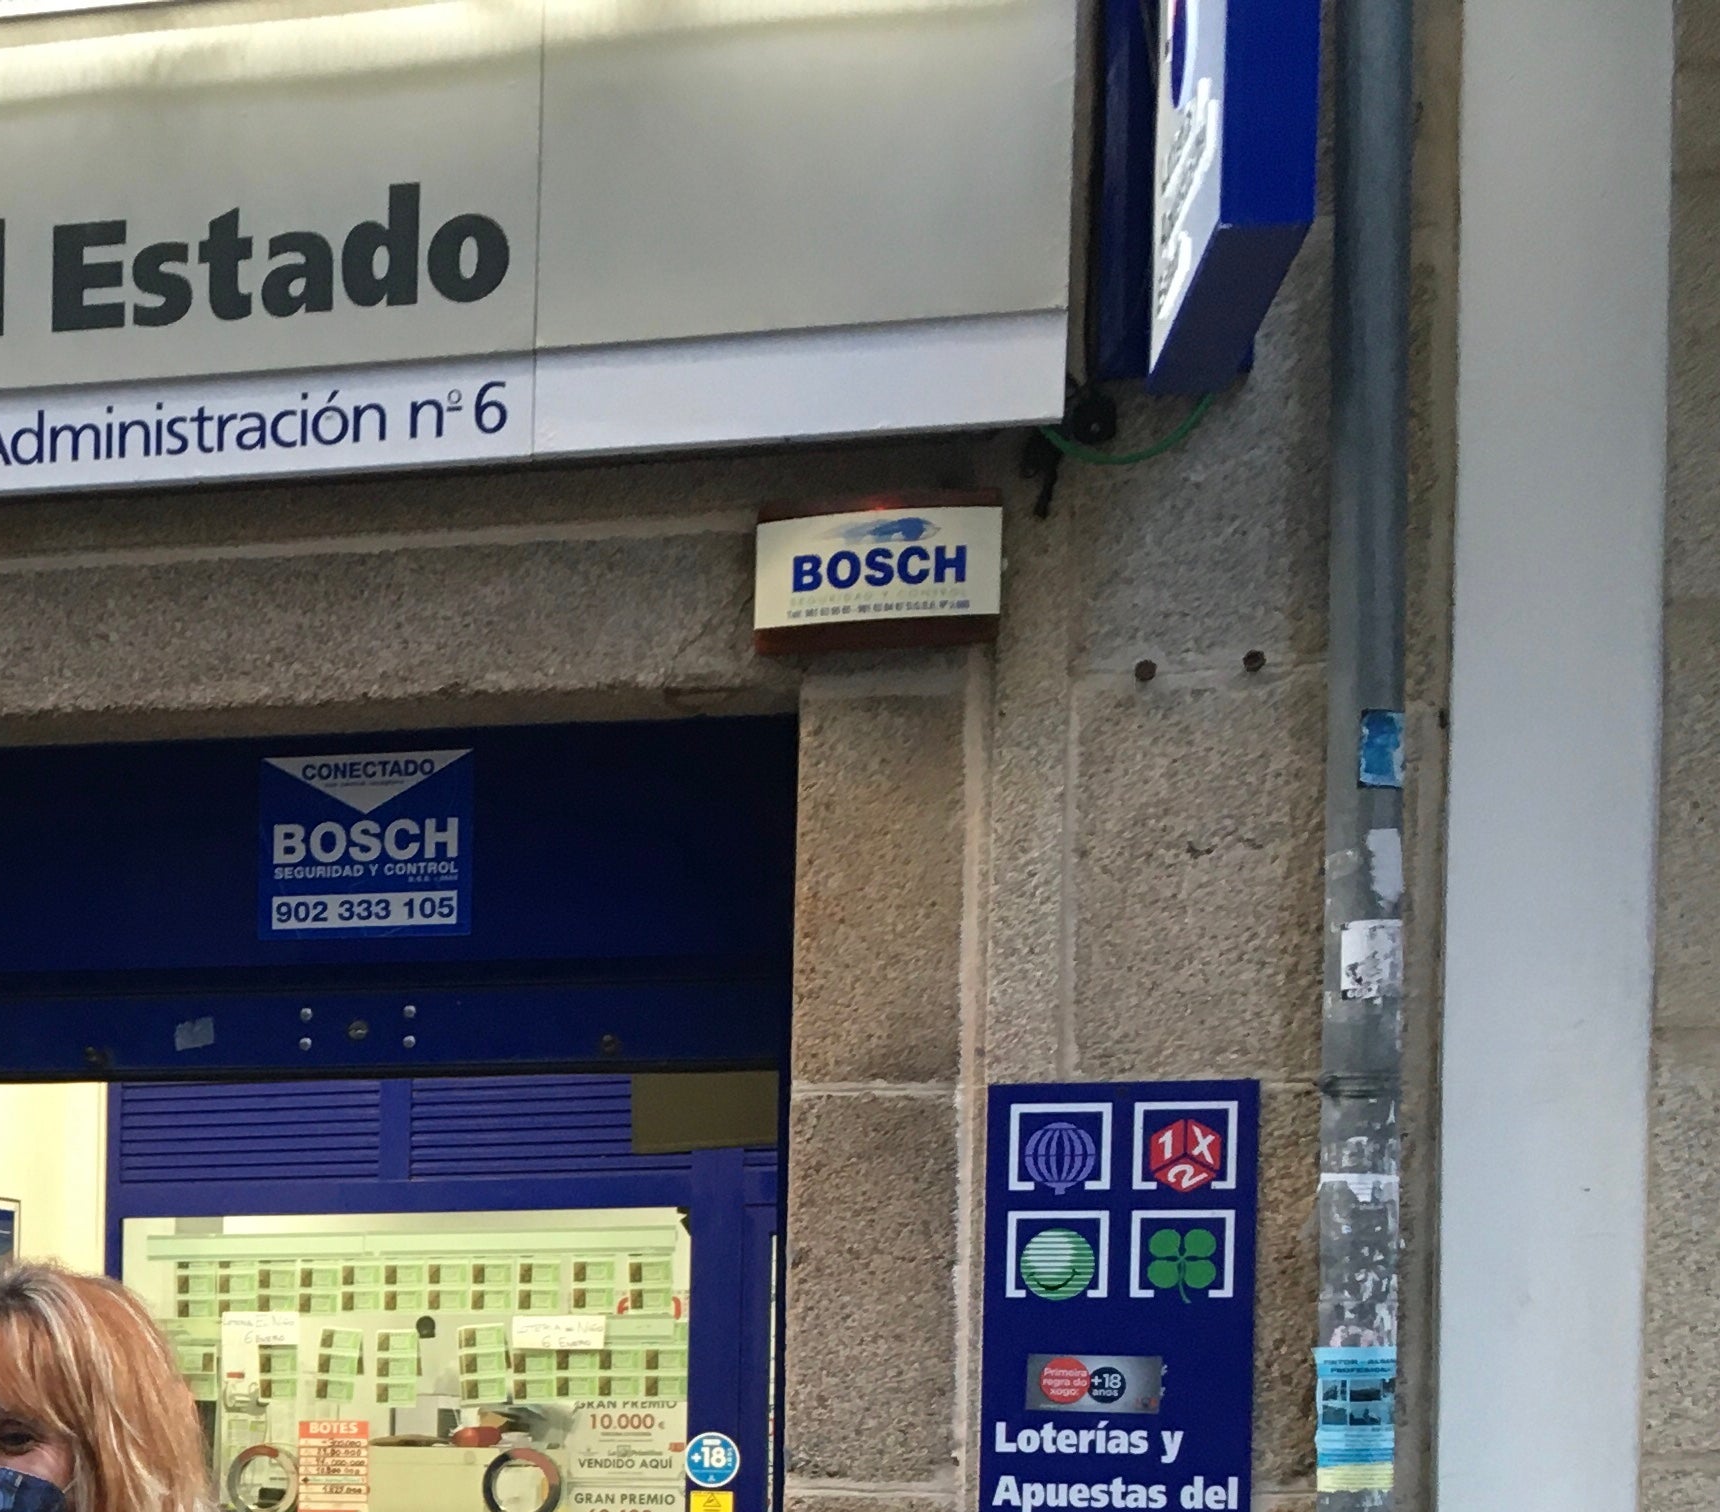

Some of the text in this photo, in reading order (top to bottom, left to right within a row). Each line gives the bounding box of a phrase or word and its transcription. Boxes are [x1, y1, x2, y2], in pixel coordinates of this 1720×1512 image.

[52, 182, 510, 331] Estado
[475, 382, 508, 434] 6
[792, 545, 967, 593] BOSCH
[302, 758, 435, 781] CONECTADO
[273, 817, 459, 864] BOSCH
[274, 861, 459, 880] SEGURIDAD Y CONTROL
[276, 897, 455, 923] 902 333 105
[1042, 1377, 1088, 1387] regra do
[1043, 1367, 1088, 1378] Primeira
[1091, 1373, 1122, 1389] +18
[309, 1422, 359, 1434] BOTES
[589, 1414, 656, 1430] 10.000
[995, 1421, 1185, 1463] Loterías y
[578, 1456, 673, 1471] VENDIDO AQUÍ
[691, 1446, 727, 1468] +18
[574, 1493, 676, 1506] GRAN PREMIO
[1180, 1477, 1238, 1510] del
